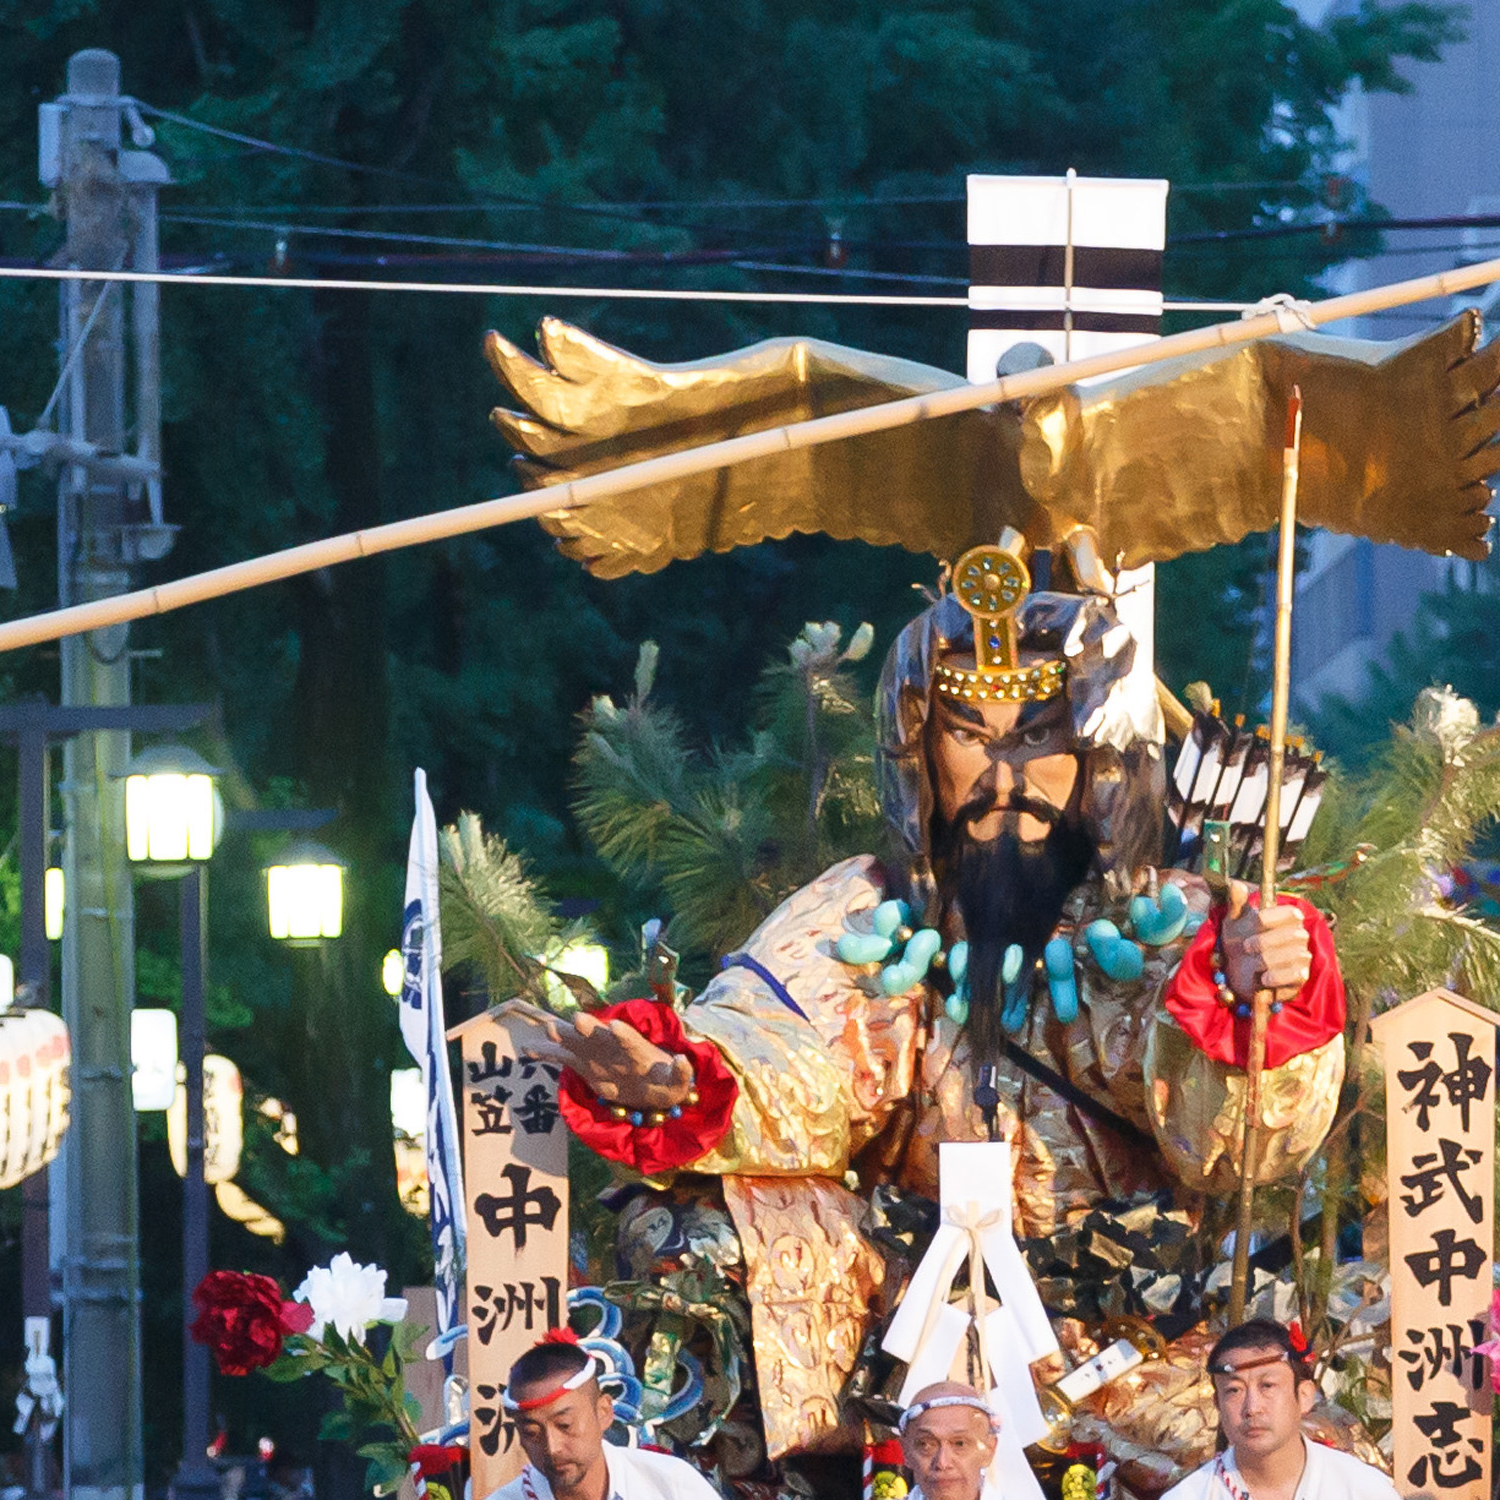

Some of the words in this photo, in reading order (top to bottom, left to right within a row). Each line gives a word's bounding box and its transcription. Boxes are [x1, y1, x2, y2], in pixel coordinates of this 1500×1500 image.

[467, 1040, 514, 1136] 山笠
[1397, 1032, 1493, 1489] 神武中洲志
